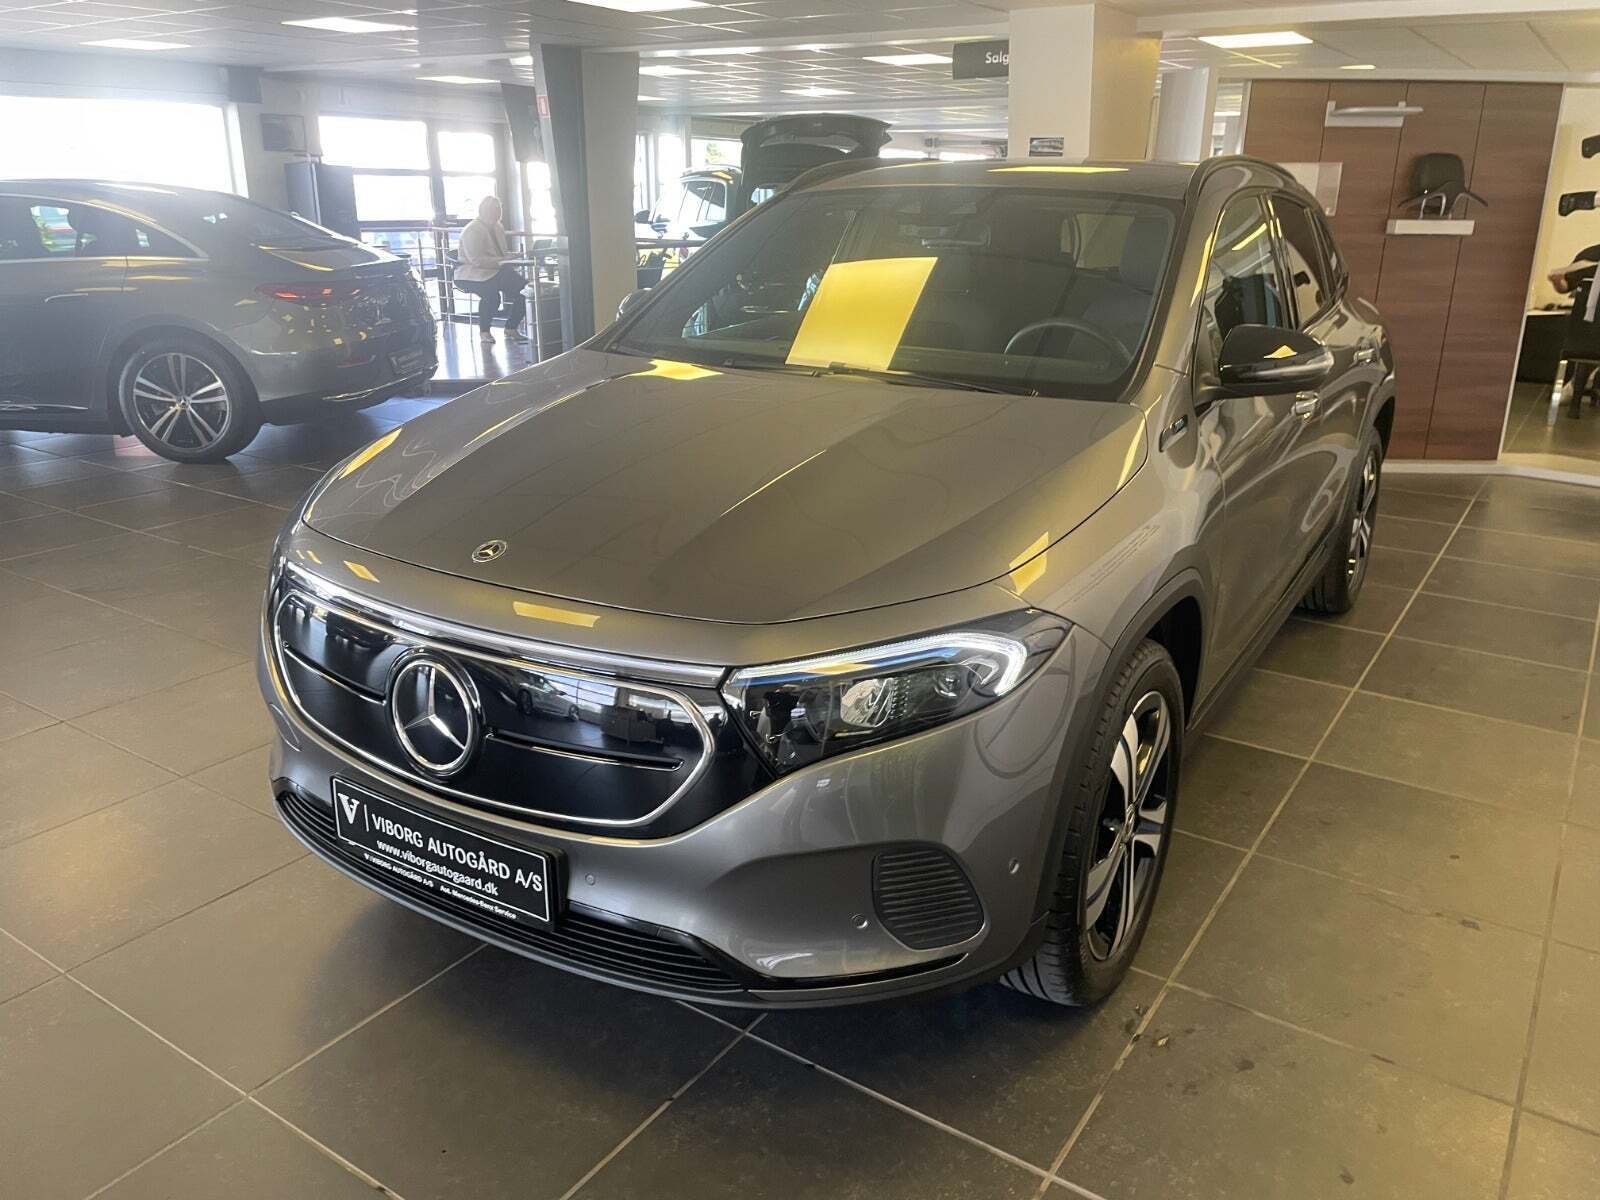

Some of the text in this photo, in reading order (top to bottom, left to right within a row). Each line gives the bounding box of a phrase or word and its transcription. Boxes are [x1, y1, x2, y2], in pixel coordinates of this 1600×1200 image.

[985, 50, 1009, 65] Salg
[371, 813, 424, 848] VIBORG
[427, 837, 511, 880] AUTOGÅRD
[514, 868, 543, 892] A/S
[376, 840, 499, 896] www.viborgautogaard.dk
